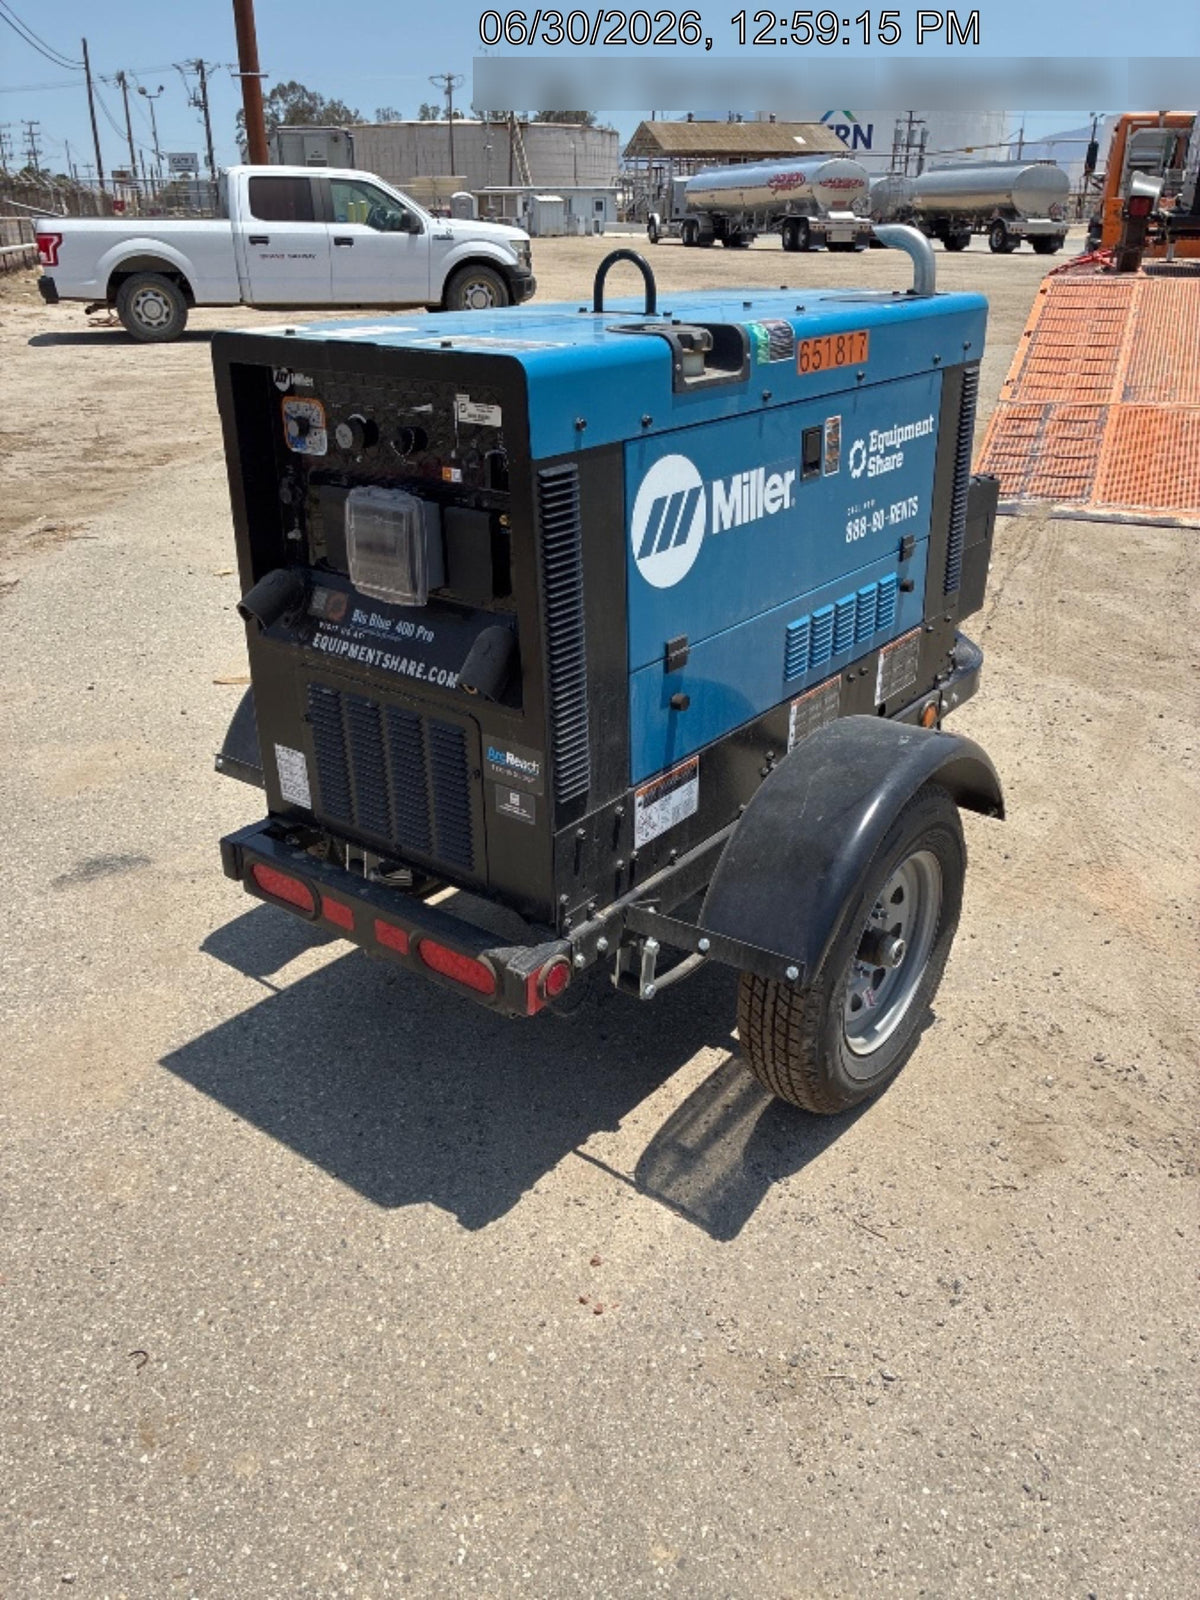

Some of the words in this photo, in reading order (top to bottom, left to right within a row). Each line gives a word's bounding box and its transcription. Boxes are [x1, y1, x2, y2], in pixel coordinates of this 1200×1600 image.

[827, 124, 874, 149] RN
[799, 332, 867, 373] 651817
[868, 414, 935, 454] Equipment
[867, 451, 904, 478] Share
[712, 467, 796, 534] Miller
[369, 612, 392, 631] Blue
[395, 619, 415, 638] 400
[416, 625, 435, 643] Pro
[312, 632, 460, 689] EQUIPMENTSHARE.COM
